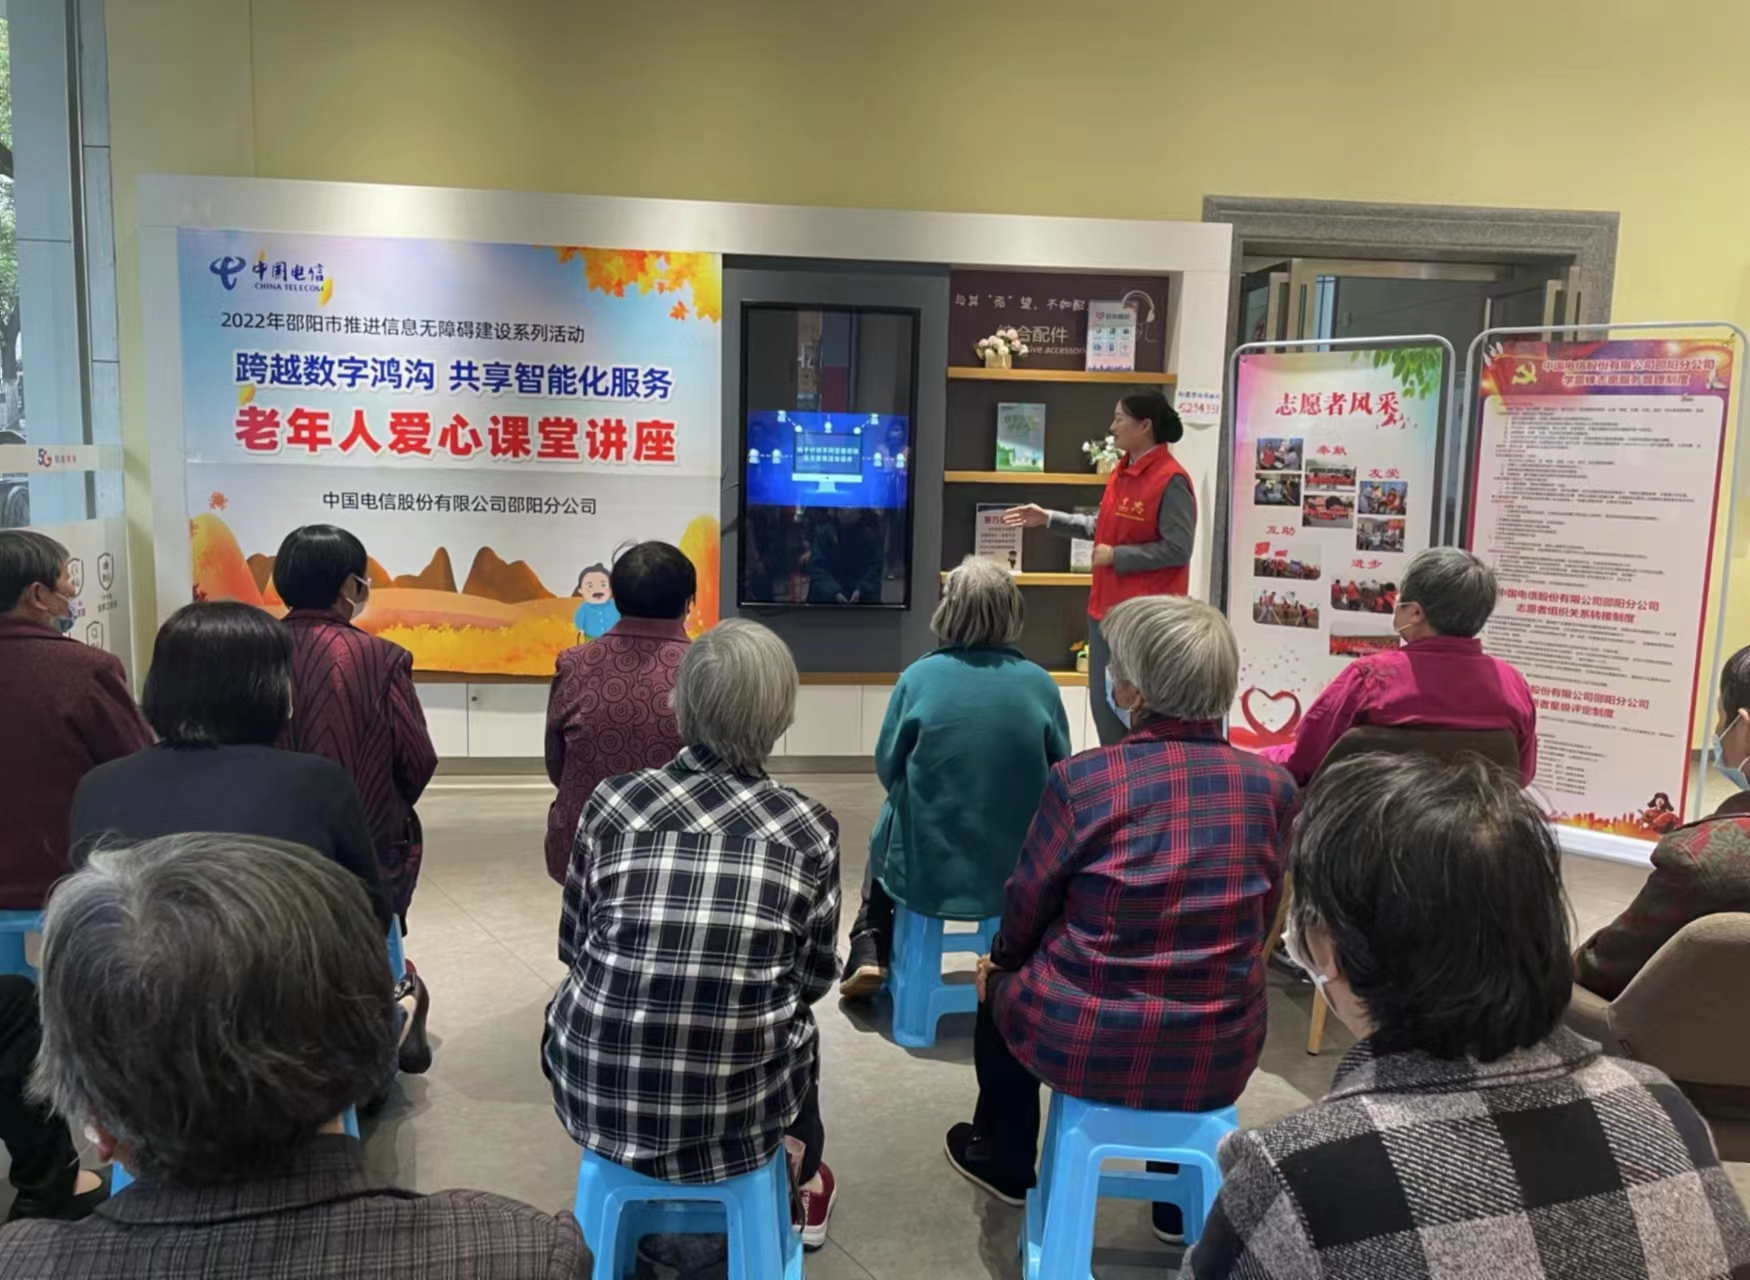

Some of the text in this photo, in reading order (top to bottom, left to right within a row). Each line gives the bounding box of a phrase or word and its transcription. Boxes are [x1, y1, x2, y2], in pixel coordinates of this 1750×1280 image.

[252, 260, 325, 282] 中国电信
[254, 282, 325, 292] CHINA TELECOM
[221, 312, 585, 344] 2022年邵阳市推进信息无障碍建设系列活动
[235, 351, 673, 400] 跨越数字鸿沟 共享智能化服务
[1275, 391, 1400, 416] 志愿者风采
[235, 405, 677, 462] 老年人爱心课堂讲座
[323, 491, 597, 515] 中国电信股份有限公司邵阳分公司
